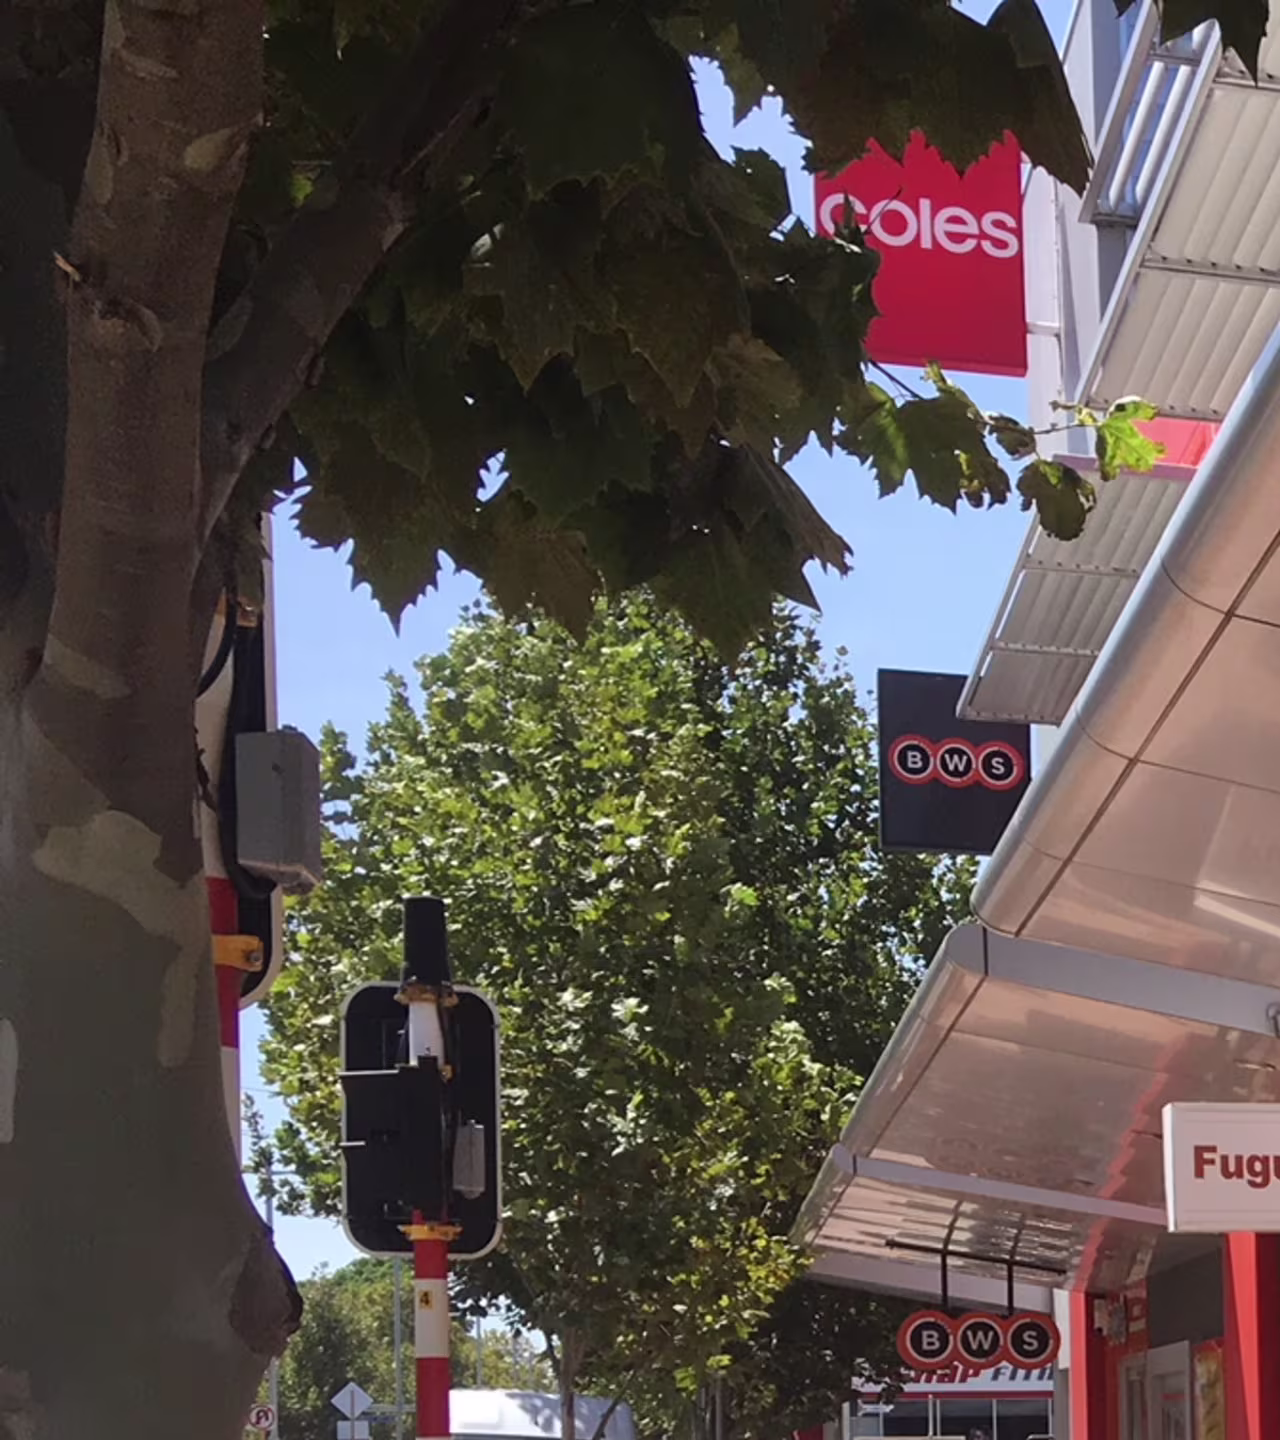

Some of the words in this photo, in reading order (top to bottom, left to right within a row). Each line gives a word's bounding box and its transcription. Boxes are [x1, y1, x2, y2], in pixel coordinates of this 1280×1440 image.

[820, 193, 1019, 258] coles
[906, 750, 1006, 775] BWS
[921, 1329, 1039, 1351] BWS
